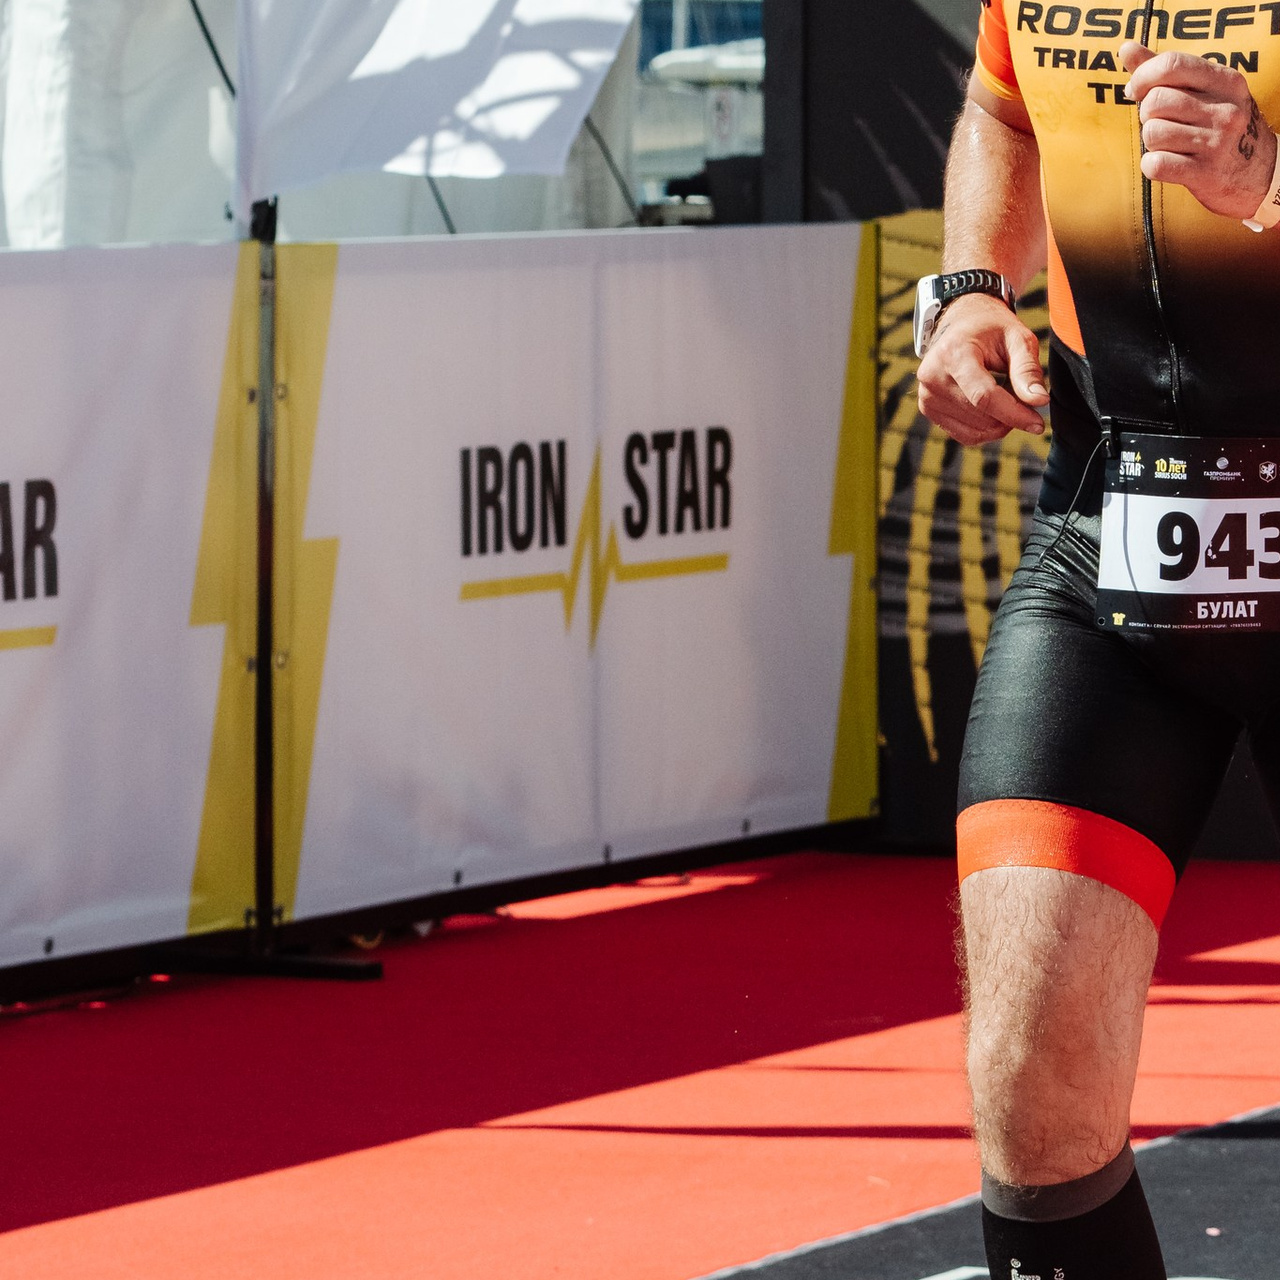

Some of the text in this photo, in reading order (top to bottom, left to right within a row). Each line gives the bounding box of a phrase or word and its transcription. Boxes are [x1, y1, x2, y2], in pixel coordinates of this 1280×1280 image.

[1033, 46, 1259, 73] TRIAON
[1155, 458, 1167, 473] 10
[459, 427, 734, 558] IRON STAR
[1197, 600, 1258, 619] БУЛАТ
